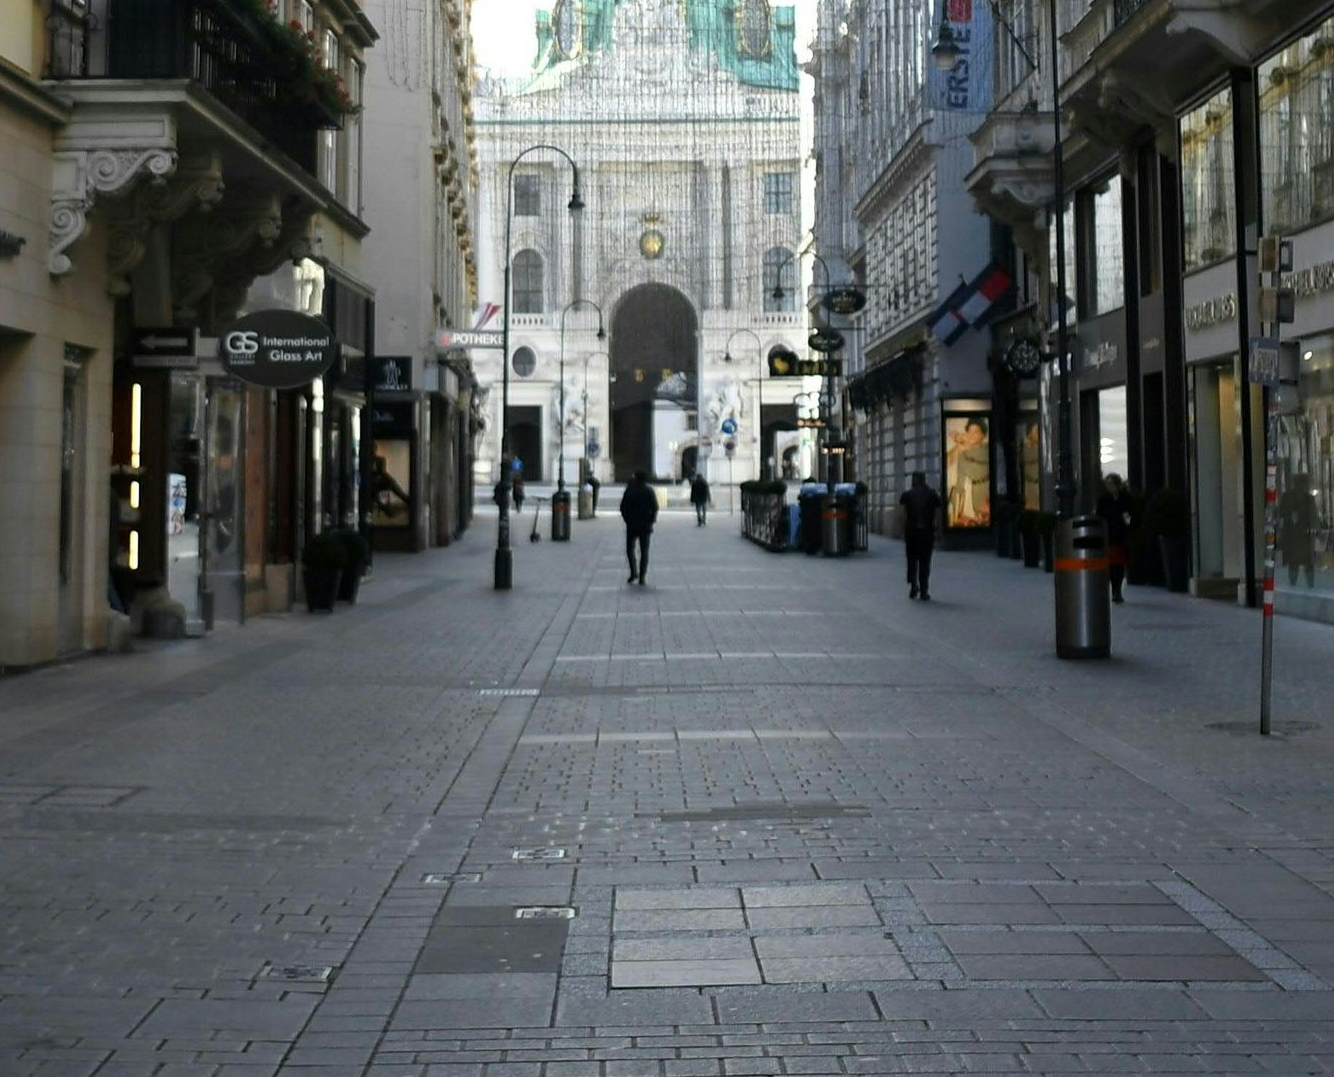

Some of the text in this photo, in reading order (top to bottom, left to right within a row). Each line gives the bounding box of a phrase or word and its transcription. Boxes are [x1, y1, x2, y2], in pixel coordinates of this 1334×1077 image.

[226, 331, 330, 355] GS International
[270, 350, 323, 362] Glass Art
